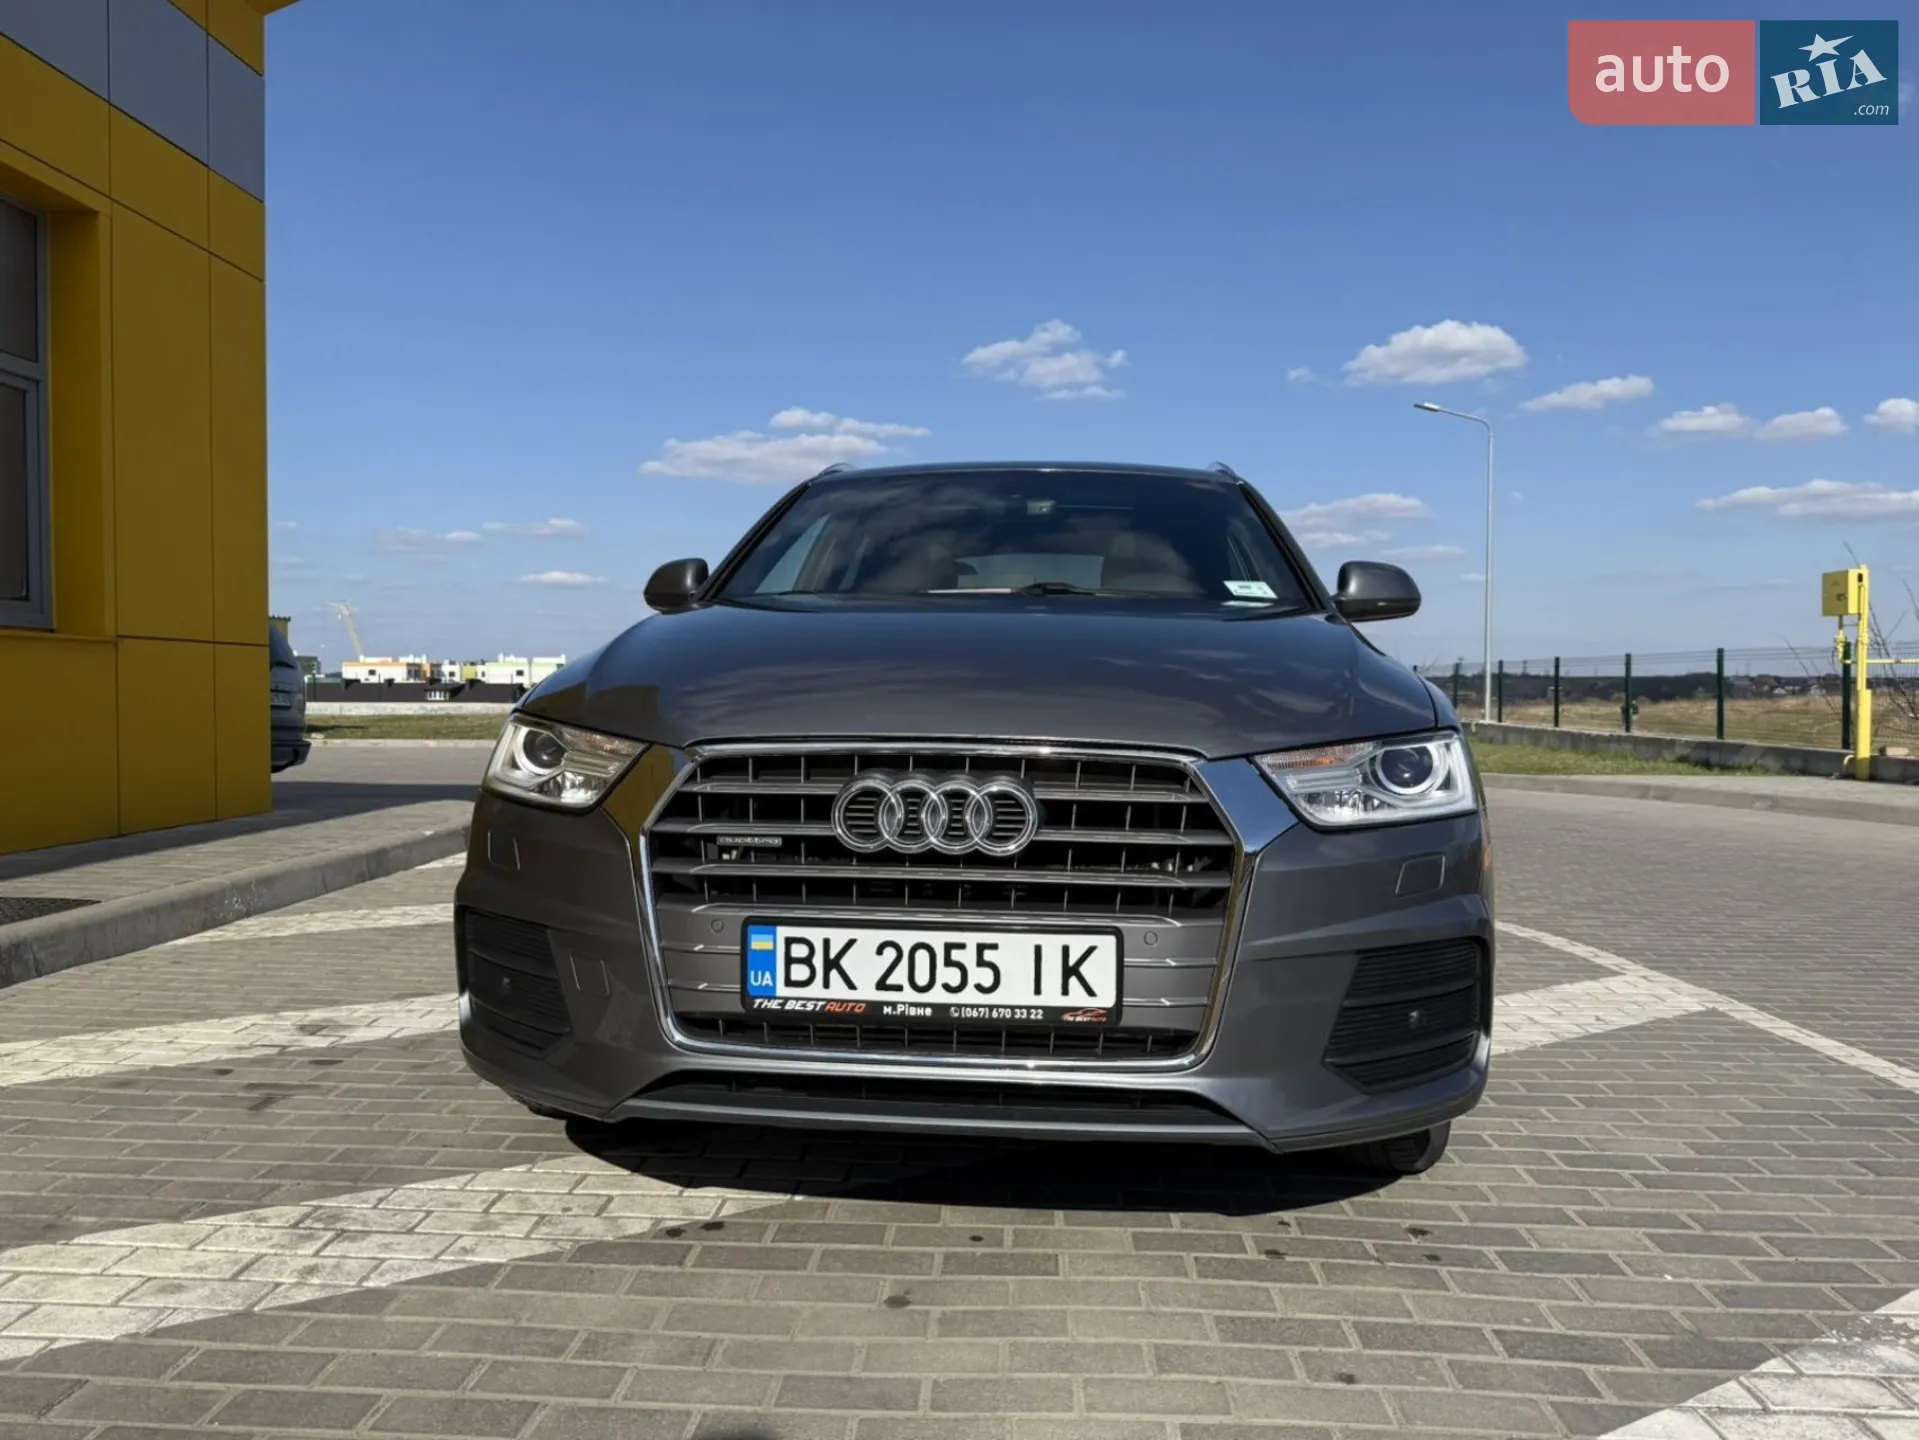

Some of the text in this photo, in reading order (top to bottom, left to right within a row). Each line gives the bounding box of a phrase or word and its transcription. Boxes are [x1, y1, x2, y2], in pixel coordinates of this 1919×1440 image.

[784, 936, 1098, 997] BK 2055 IK
[750, 970, 773, 987] UA
[753, 999, 866, 1013] THE BEST AUTO
[961, 1007, 1044, 1020] (067) 670 33 22
